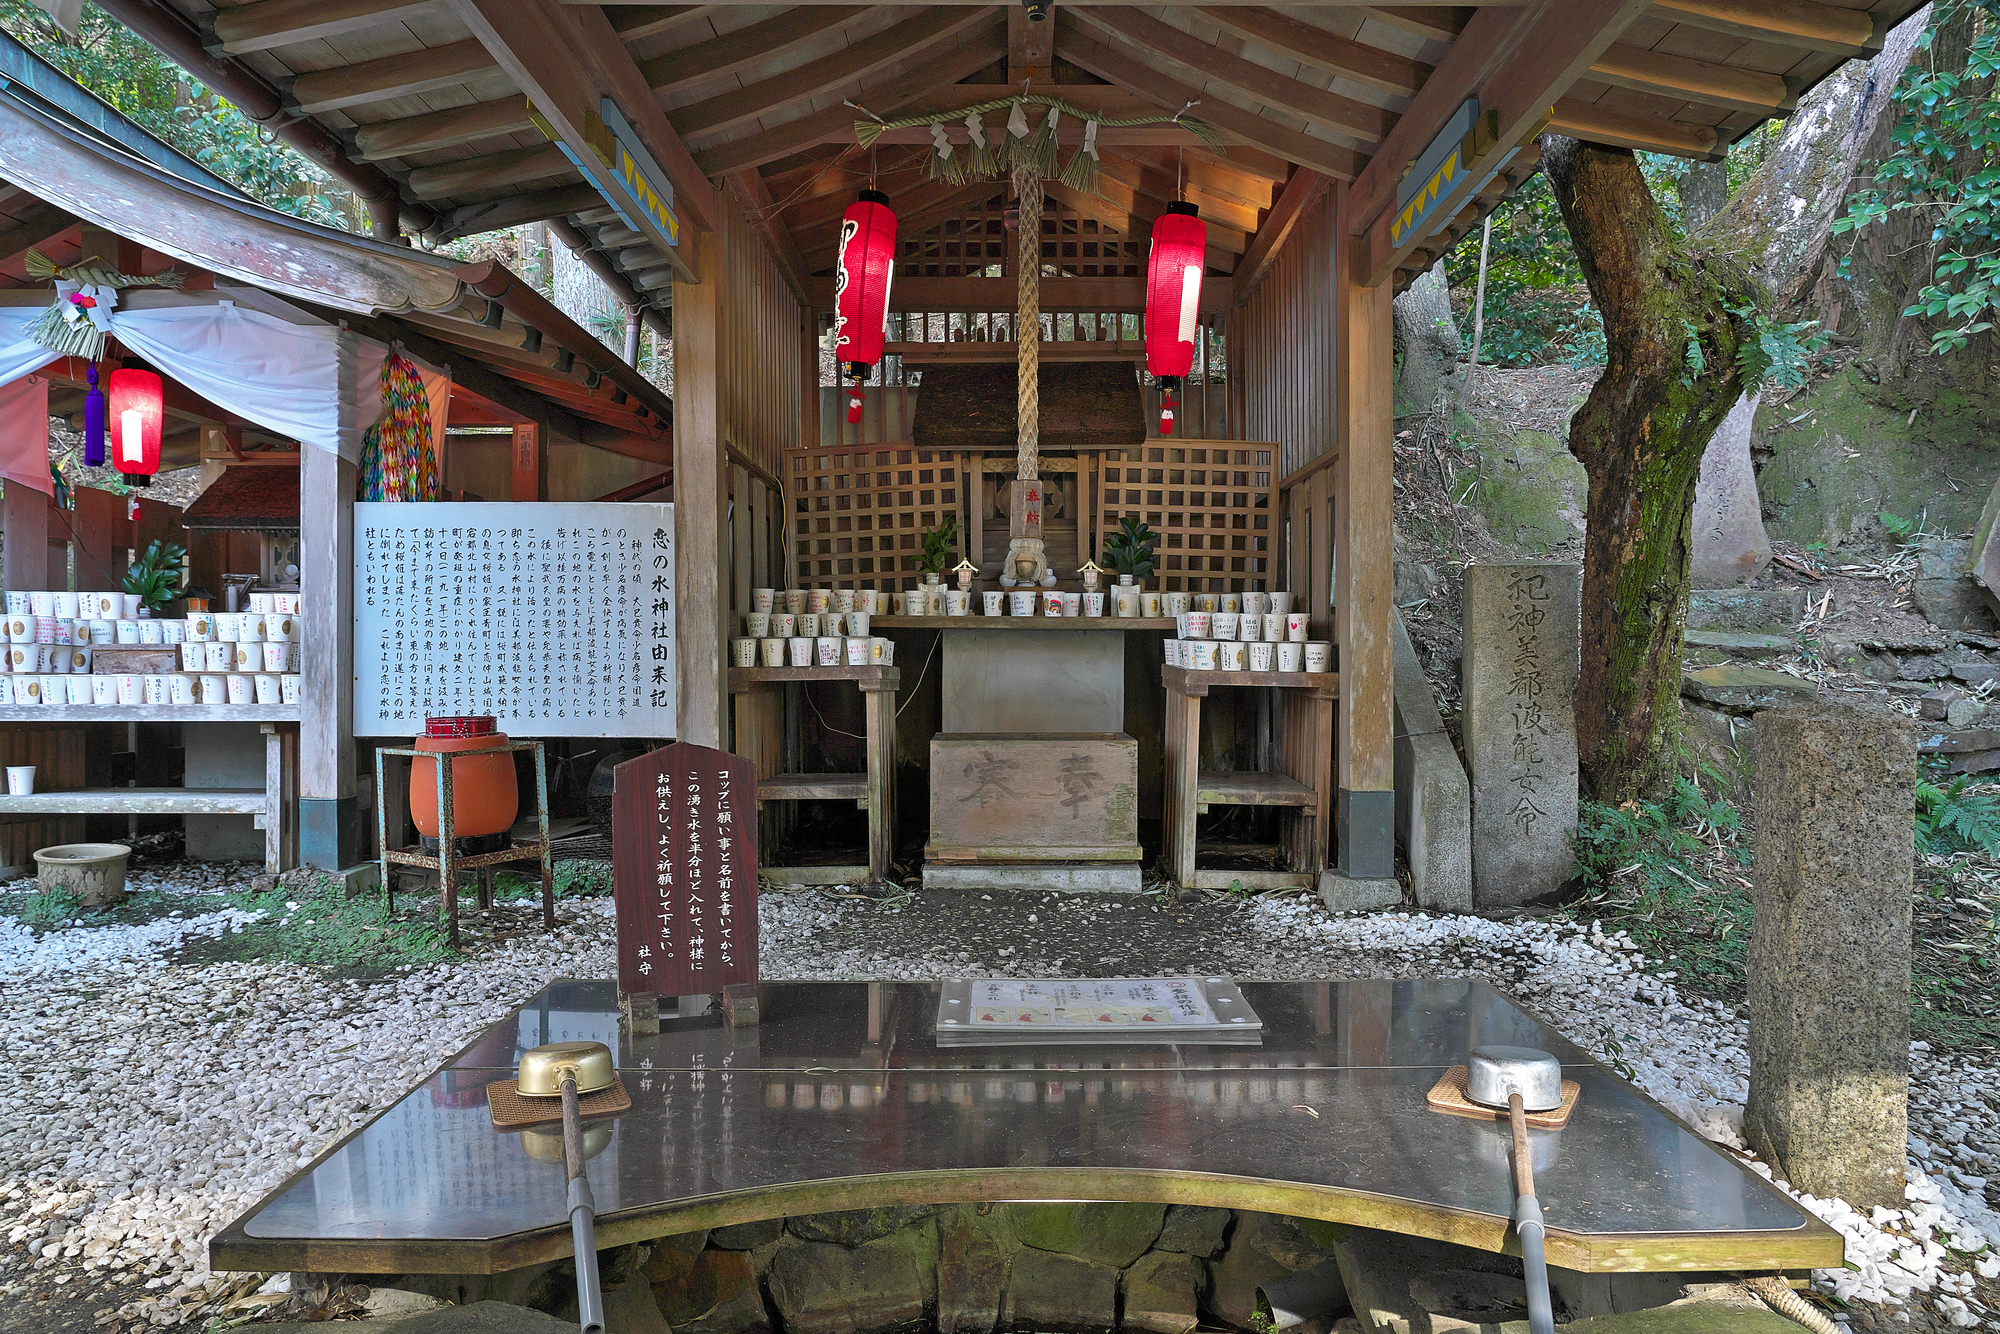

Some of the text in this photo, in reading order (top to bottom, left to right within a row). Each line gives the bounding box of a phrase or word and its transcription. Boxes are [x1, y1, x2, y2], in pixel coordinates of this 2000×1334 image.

[365, 527, 377, 607] 社ともいわれる
[631, 539, 643, 585] 神代の頃
[1027, 488, 1041, 526] 奉納
[650, 528, 670, 708] 恋の水神社由来記
[655, 772, 674, 959] お供えし、よく祈願して下さい。
[686, 771, 705, 971] この湧き水を半分ほど入れて、神様に
[716, 770, 734, 968] コップに願い事と名前を書いてから、
[638, 945, 653, 976] 社守
